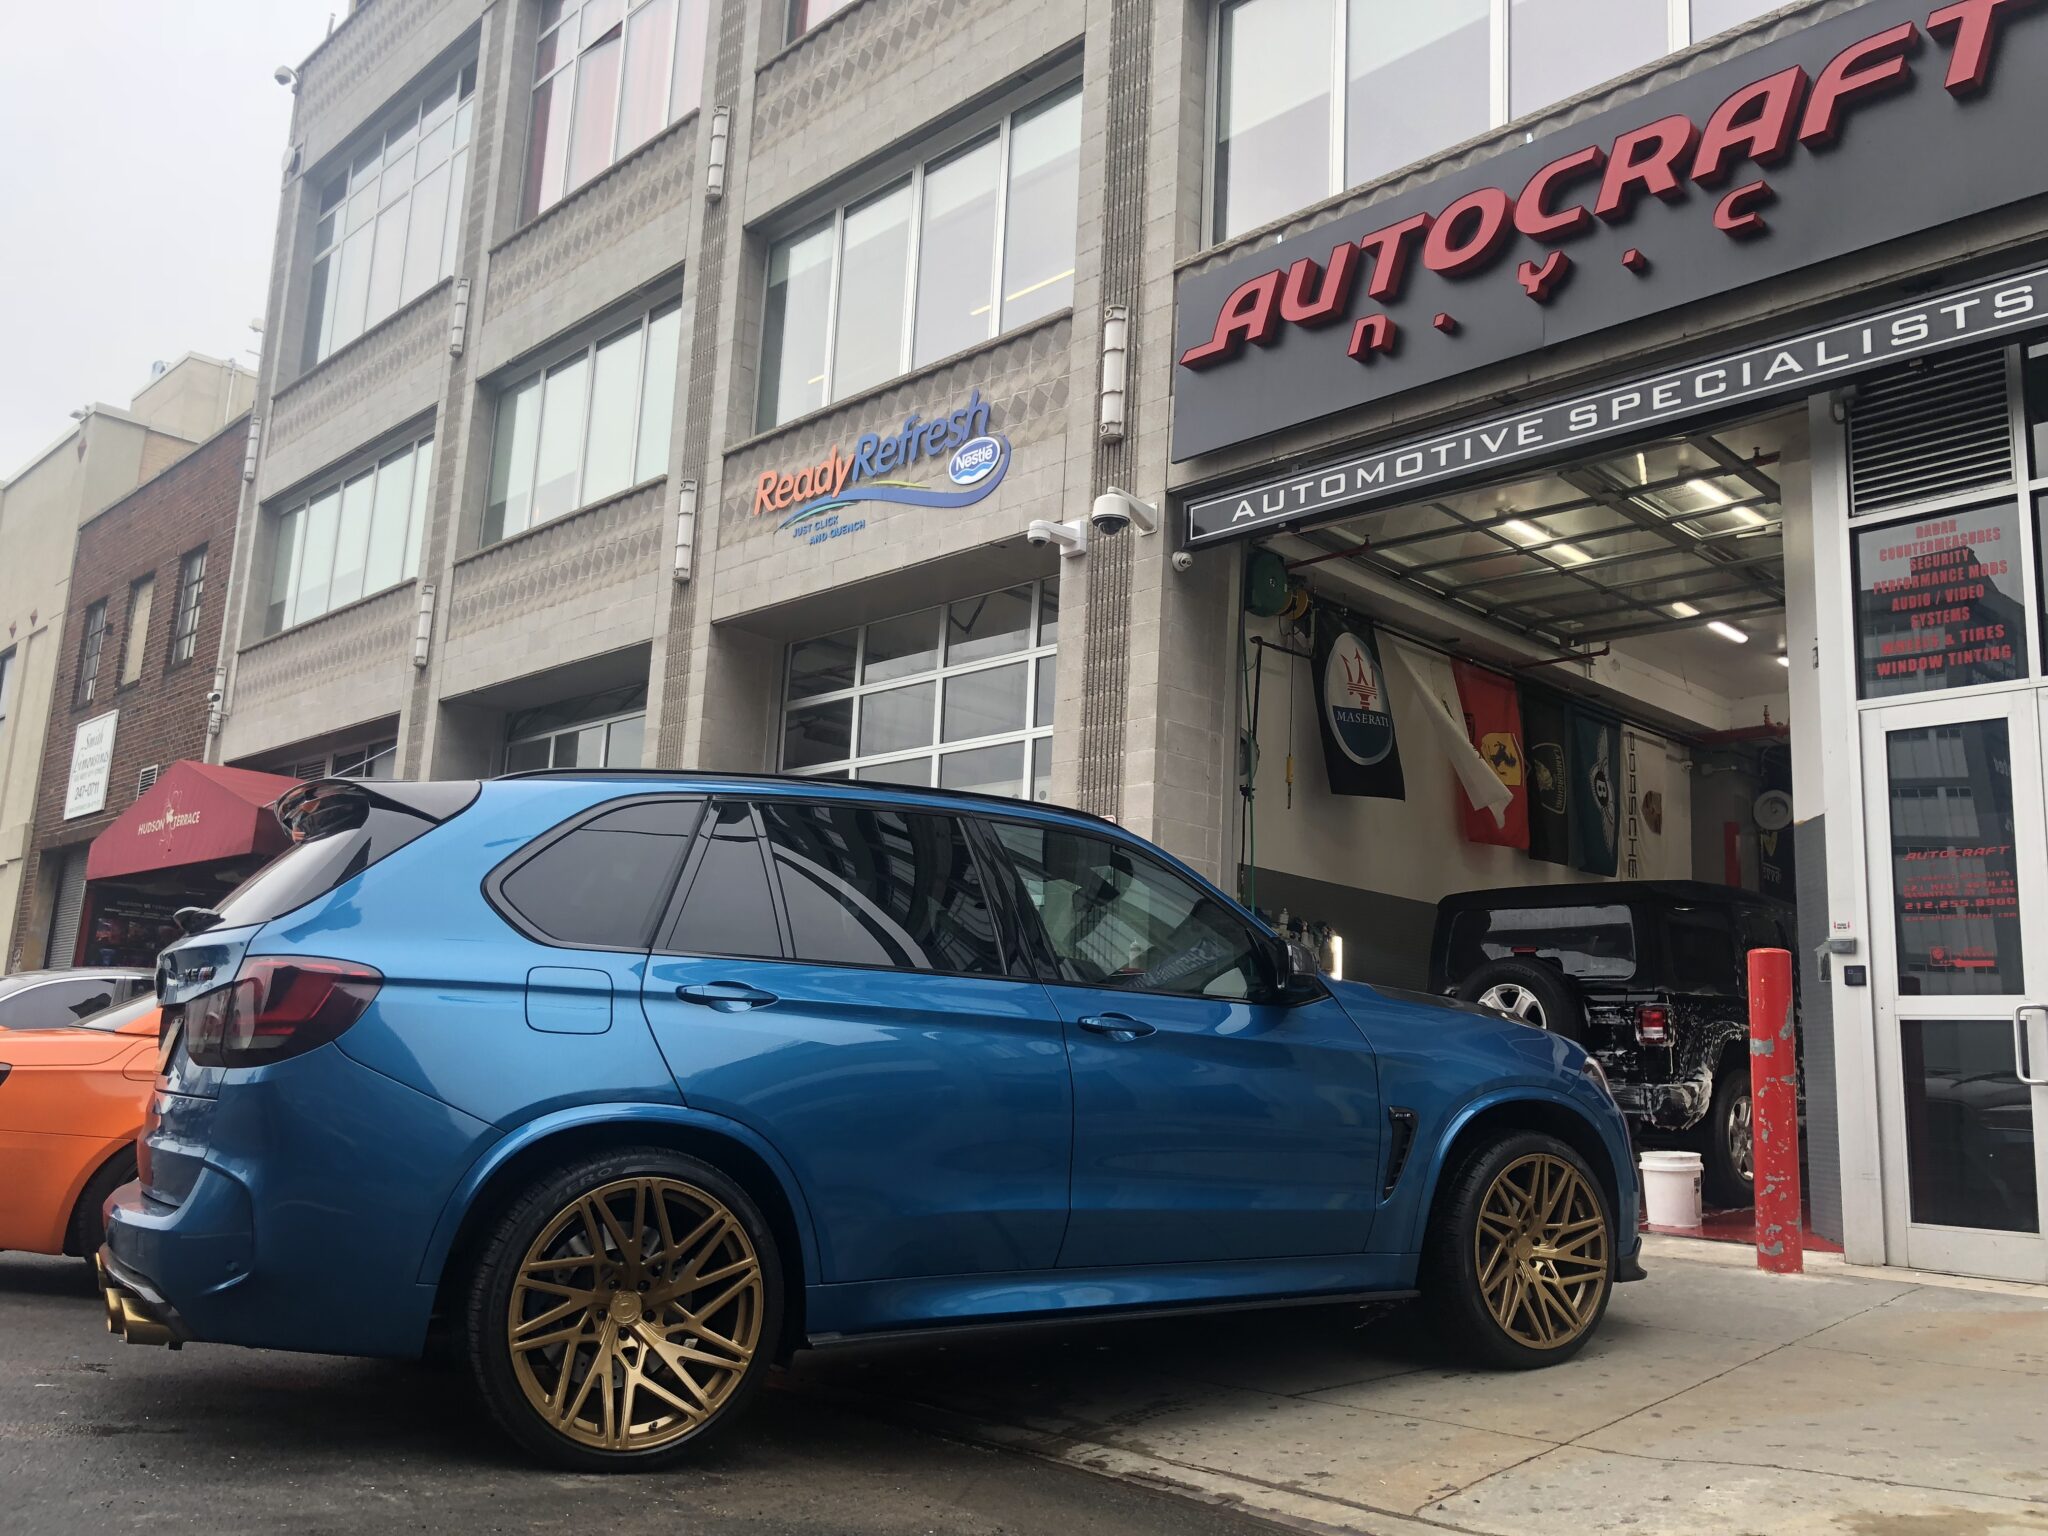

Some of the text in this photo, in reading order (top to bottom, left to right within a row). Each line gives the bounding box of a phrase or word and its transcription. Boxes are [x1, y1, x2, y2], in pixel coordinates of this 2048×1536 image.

[1180, 0, 2008, 370] AUTOCRAFT
[1231, 285, 2034, 523] AUTOMOTIVE SPECIALISTS
[792, 515, 839, 537] JUST CLICK
[809, 519, 866, 545] AND QUENCH
[1879, 527, 2001, 561] COUNTERMEASURES
[1910, 549, 1969, 572] SECURITY
[1873, 560, 2008, 595] PERFORMANCE MODS
[1892, 592, 1931, 612] AUDIO
[1945, 584, 1985, 603] VIDEO
[1911, 606, 1970, 629] SYSTEMS
[1961, 624, 2006, 643] TIRES
[1877, 645, 2012, 677] WINDOW TINTING
[1337, 710, 1389, 727] MASERATI
[1627, 731, 1638, 880] PORSCHE
[138, 811, 200, 836] HUDSON TERRACE
[1903, 845, 2011, 861] AUTOCRAFT
